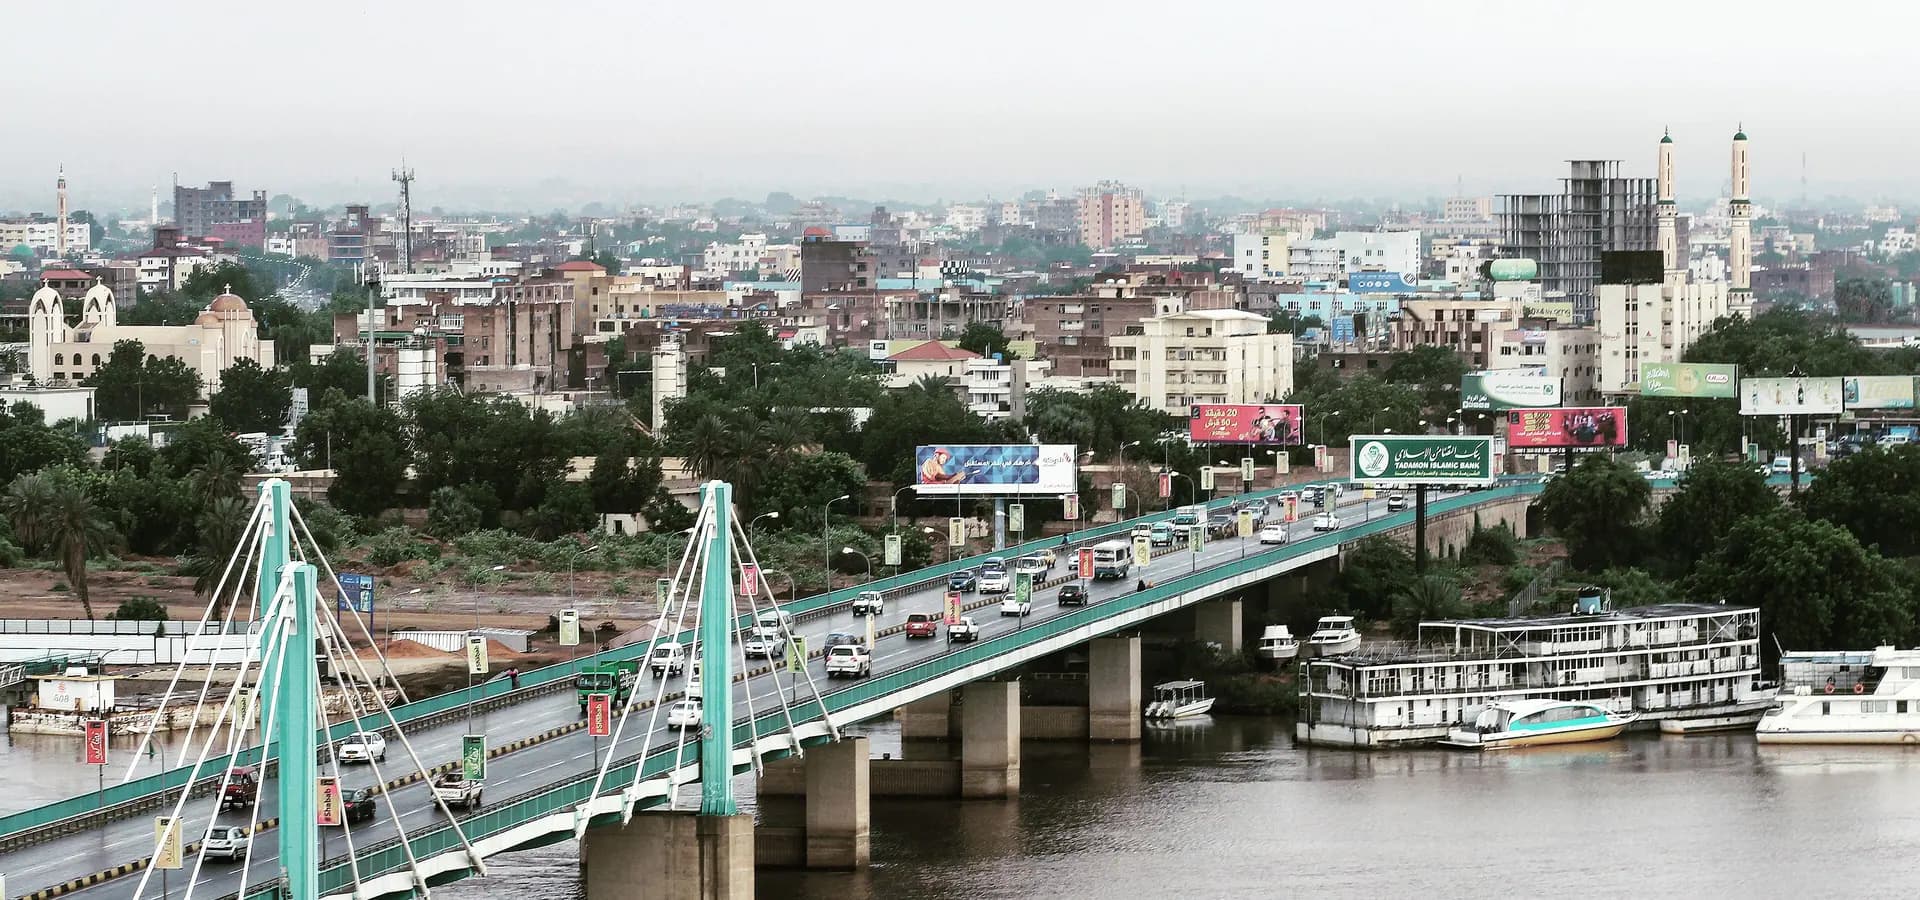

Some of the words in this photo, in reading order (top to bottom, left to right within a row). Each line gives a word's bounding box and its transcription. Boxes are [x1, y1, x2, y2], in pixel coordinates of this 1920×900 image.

[1205, 408, 1226, 419] دقيقة
[1226, 408, 1238, 417] 20
[1221, 418, 1231, 426] 50
[1430, 445, 1457, 462] التضامن
[1455, 441, 1485, 460] بنك
[322, 788, 332, 822] #Shabab
